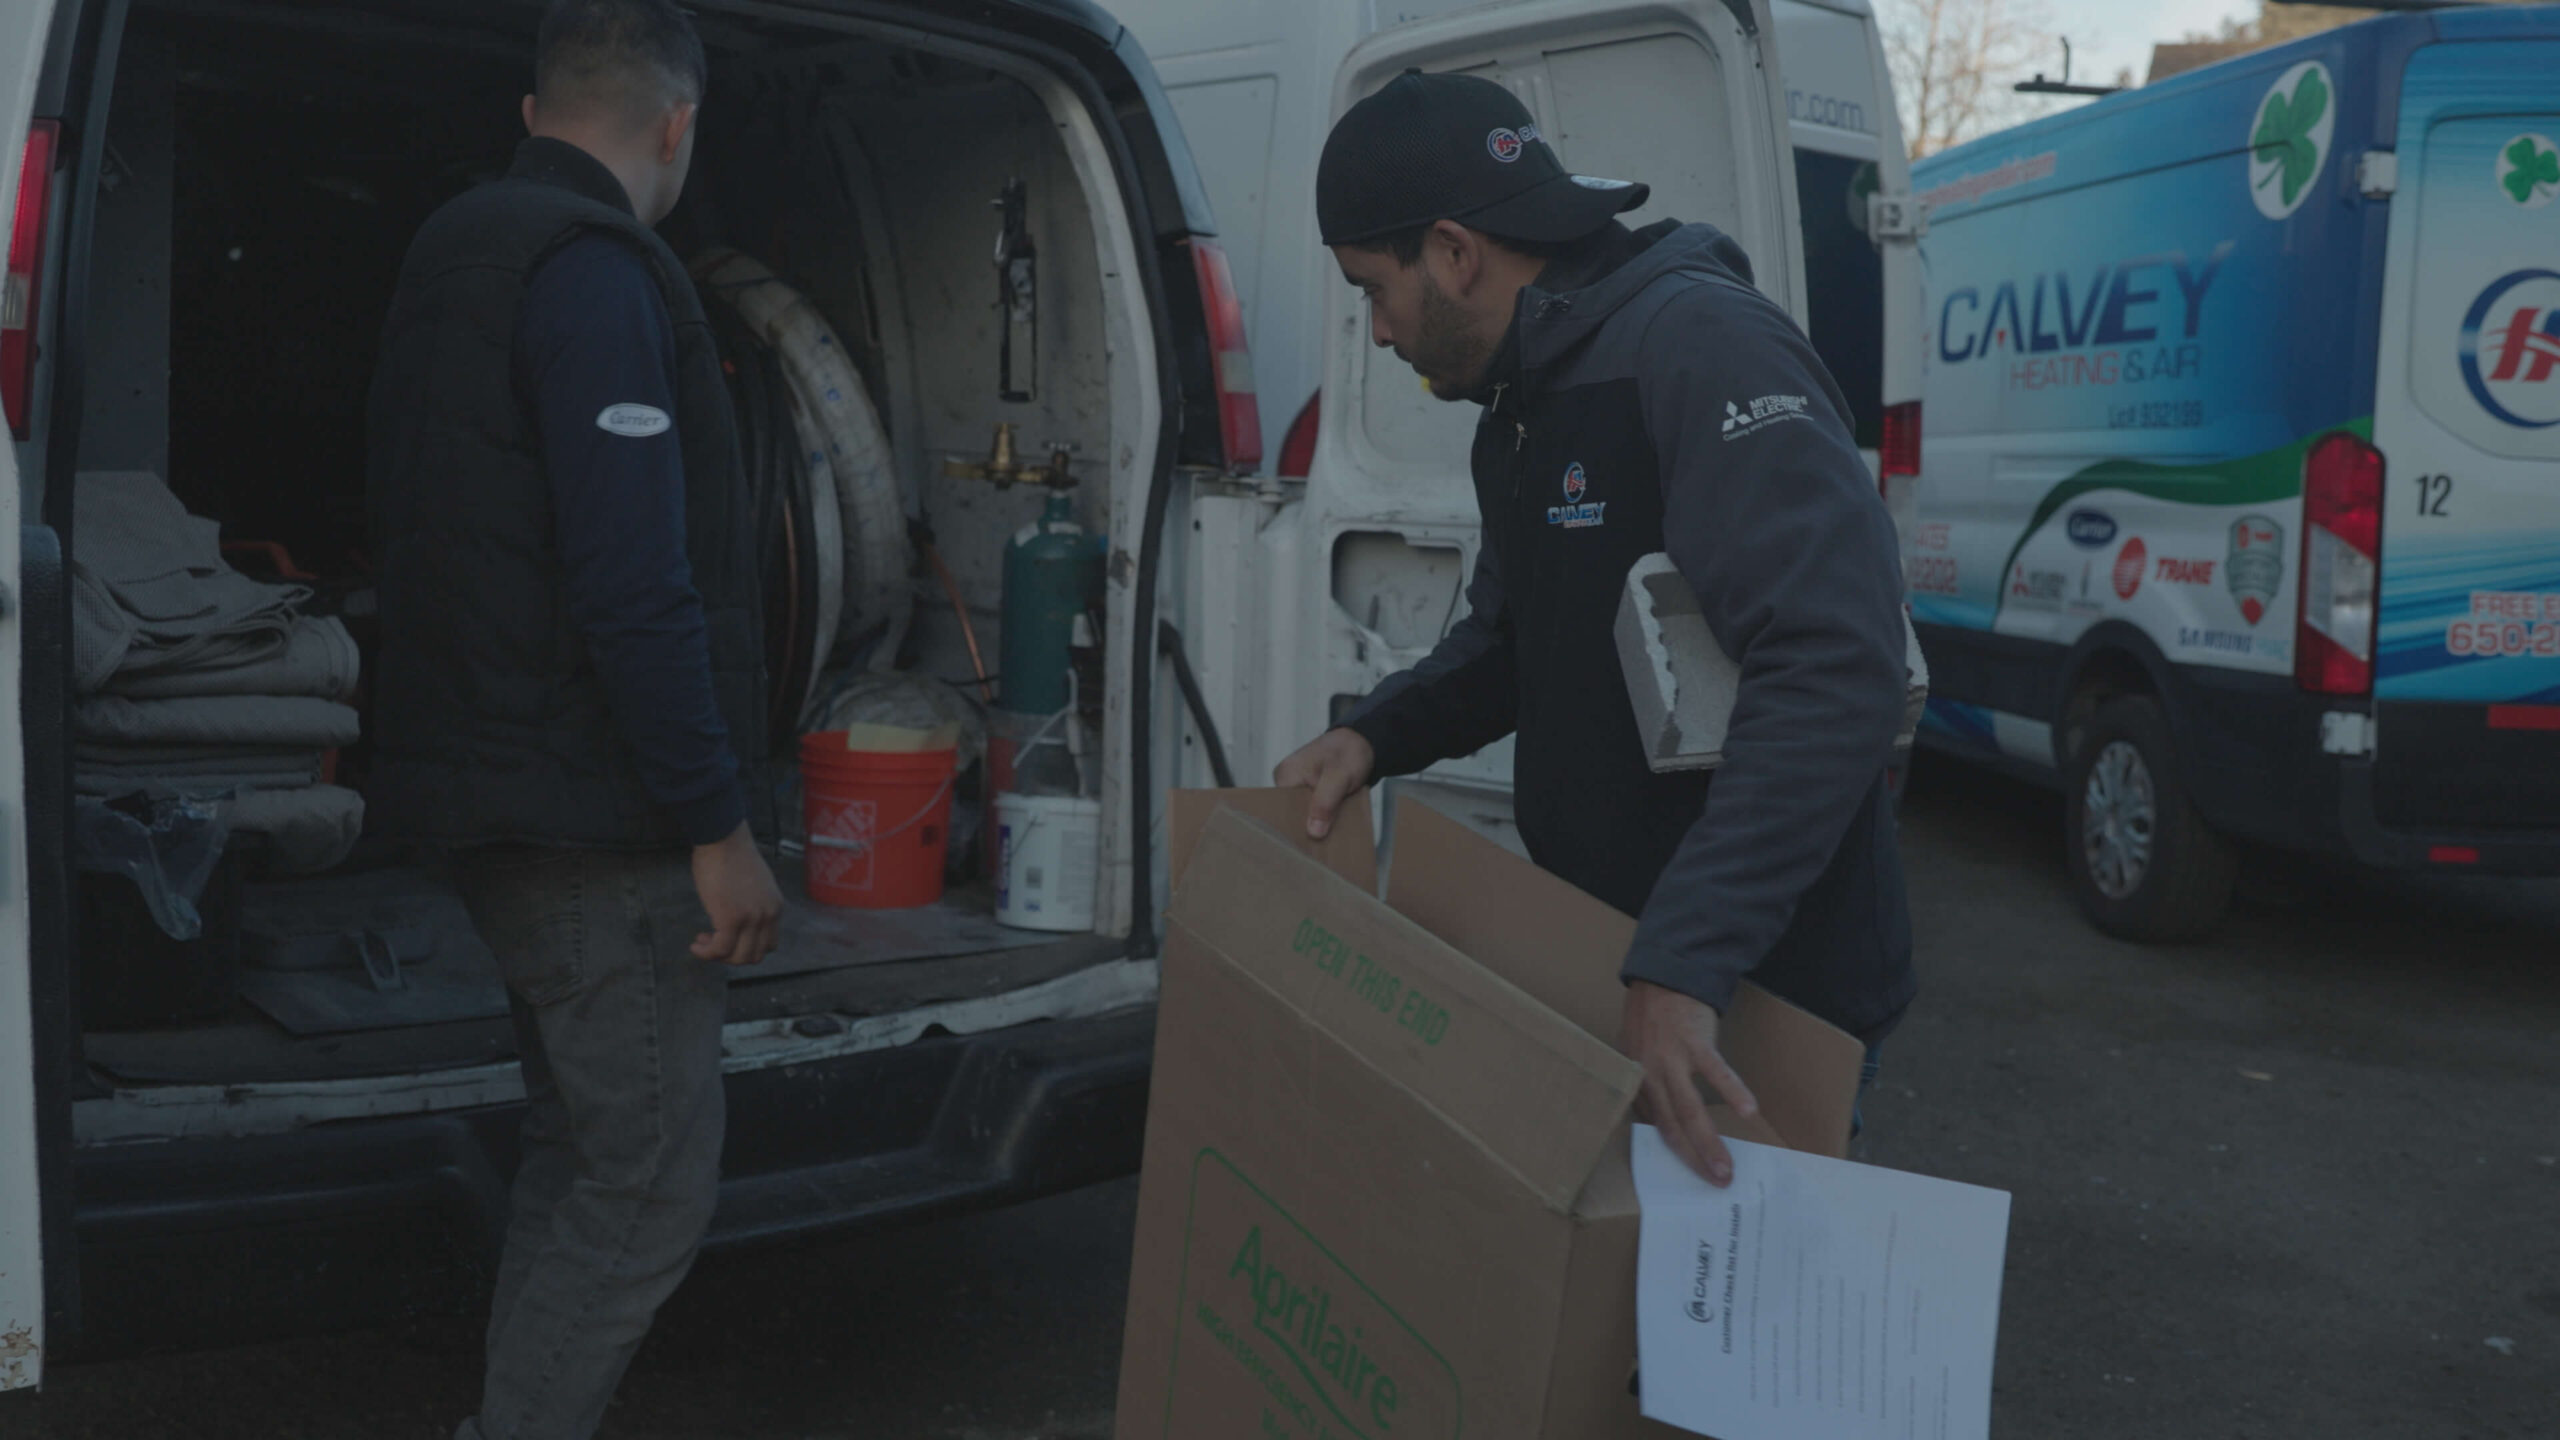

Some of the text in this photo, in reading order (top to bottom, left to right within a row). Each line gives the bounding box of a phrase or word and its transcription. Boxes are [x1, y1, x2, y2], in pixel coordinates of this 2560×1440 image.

[1939, 240, 2236, 364] CALVEY
[2010, 344, 2203, 391] HEATING & AIR
[609, 410, 662, 427] Carrier
[1547, 501, 1606, 525] CALVEY
[2416, 473, 2452, 516] 12
[2154, 556, 2217, 585] TRANE
[2472, 593, 2536, 621] FREE
[2449, 621, 2560, 656] 650-2
[1291, 915, 1451, 1046] OPEN THIS END
[1695, 1239, 1713, 1299] CALVEY
[1724, 1273, 1736, 1304] Check
[1228, 1223, 1398, 1431] Aprilaire
[1721, 1307, 1733, 1355] Customer
